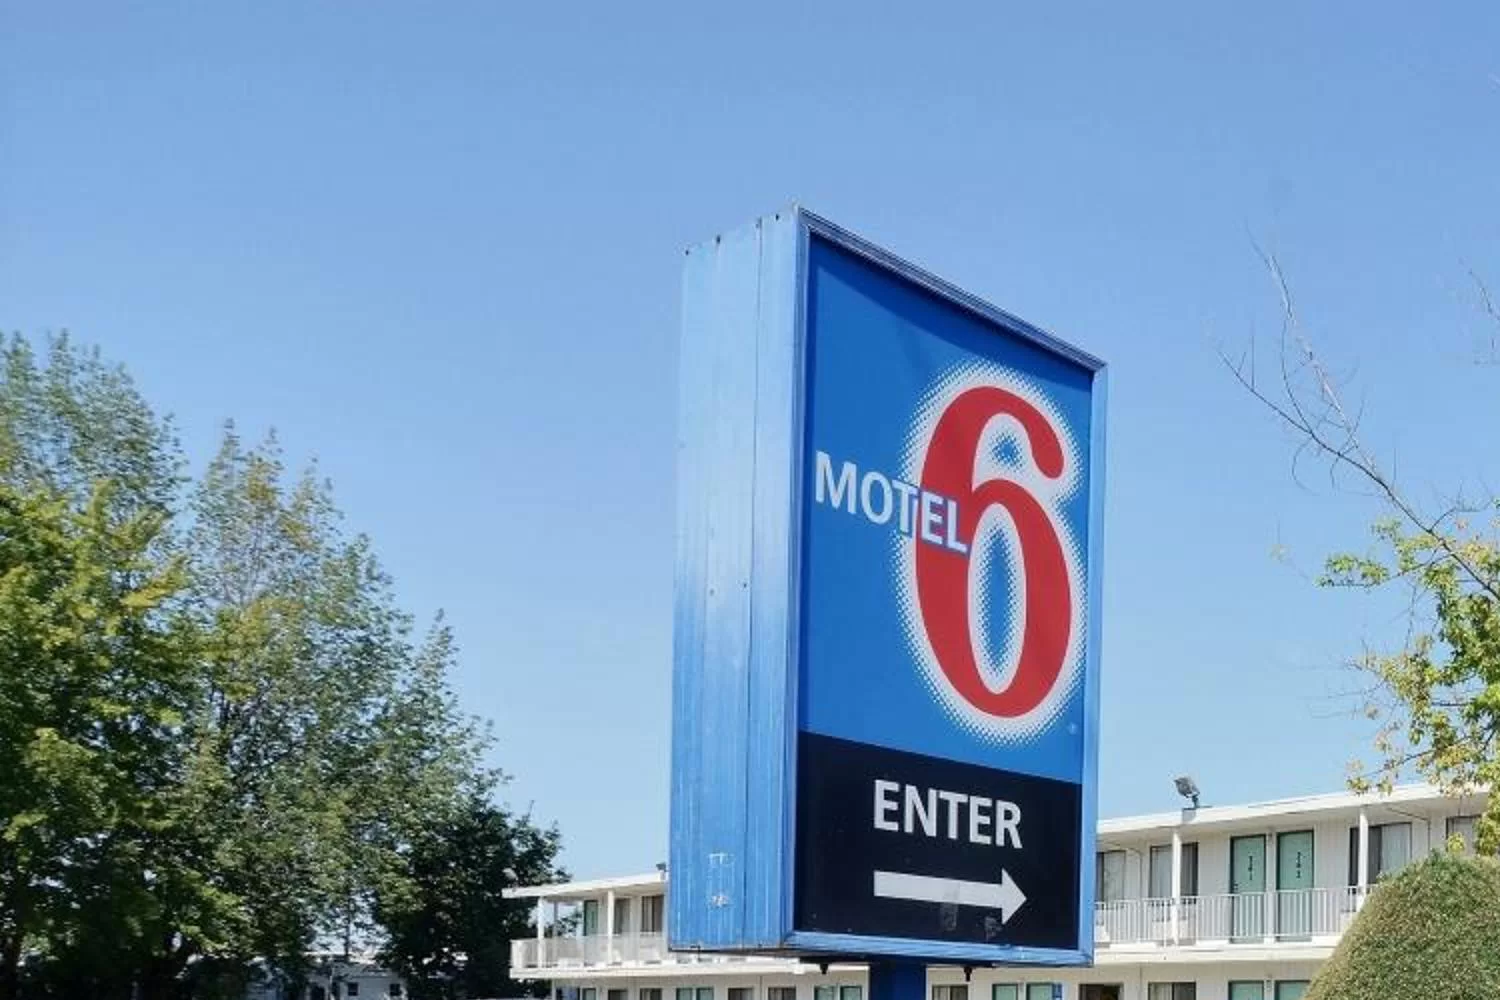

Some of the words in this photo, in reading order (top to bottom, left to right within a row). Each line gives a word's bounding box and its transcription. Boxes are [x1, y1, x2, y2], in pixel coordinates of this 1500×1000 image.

[815, 450, 968, 553] MOTEL
[914, 386, 1072, 719] 6
[873, 779, 1023, 849] ENTER
